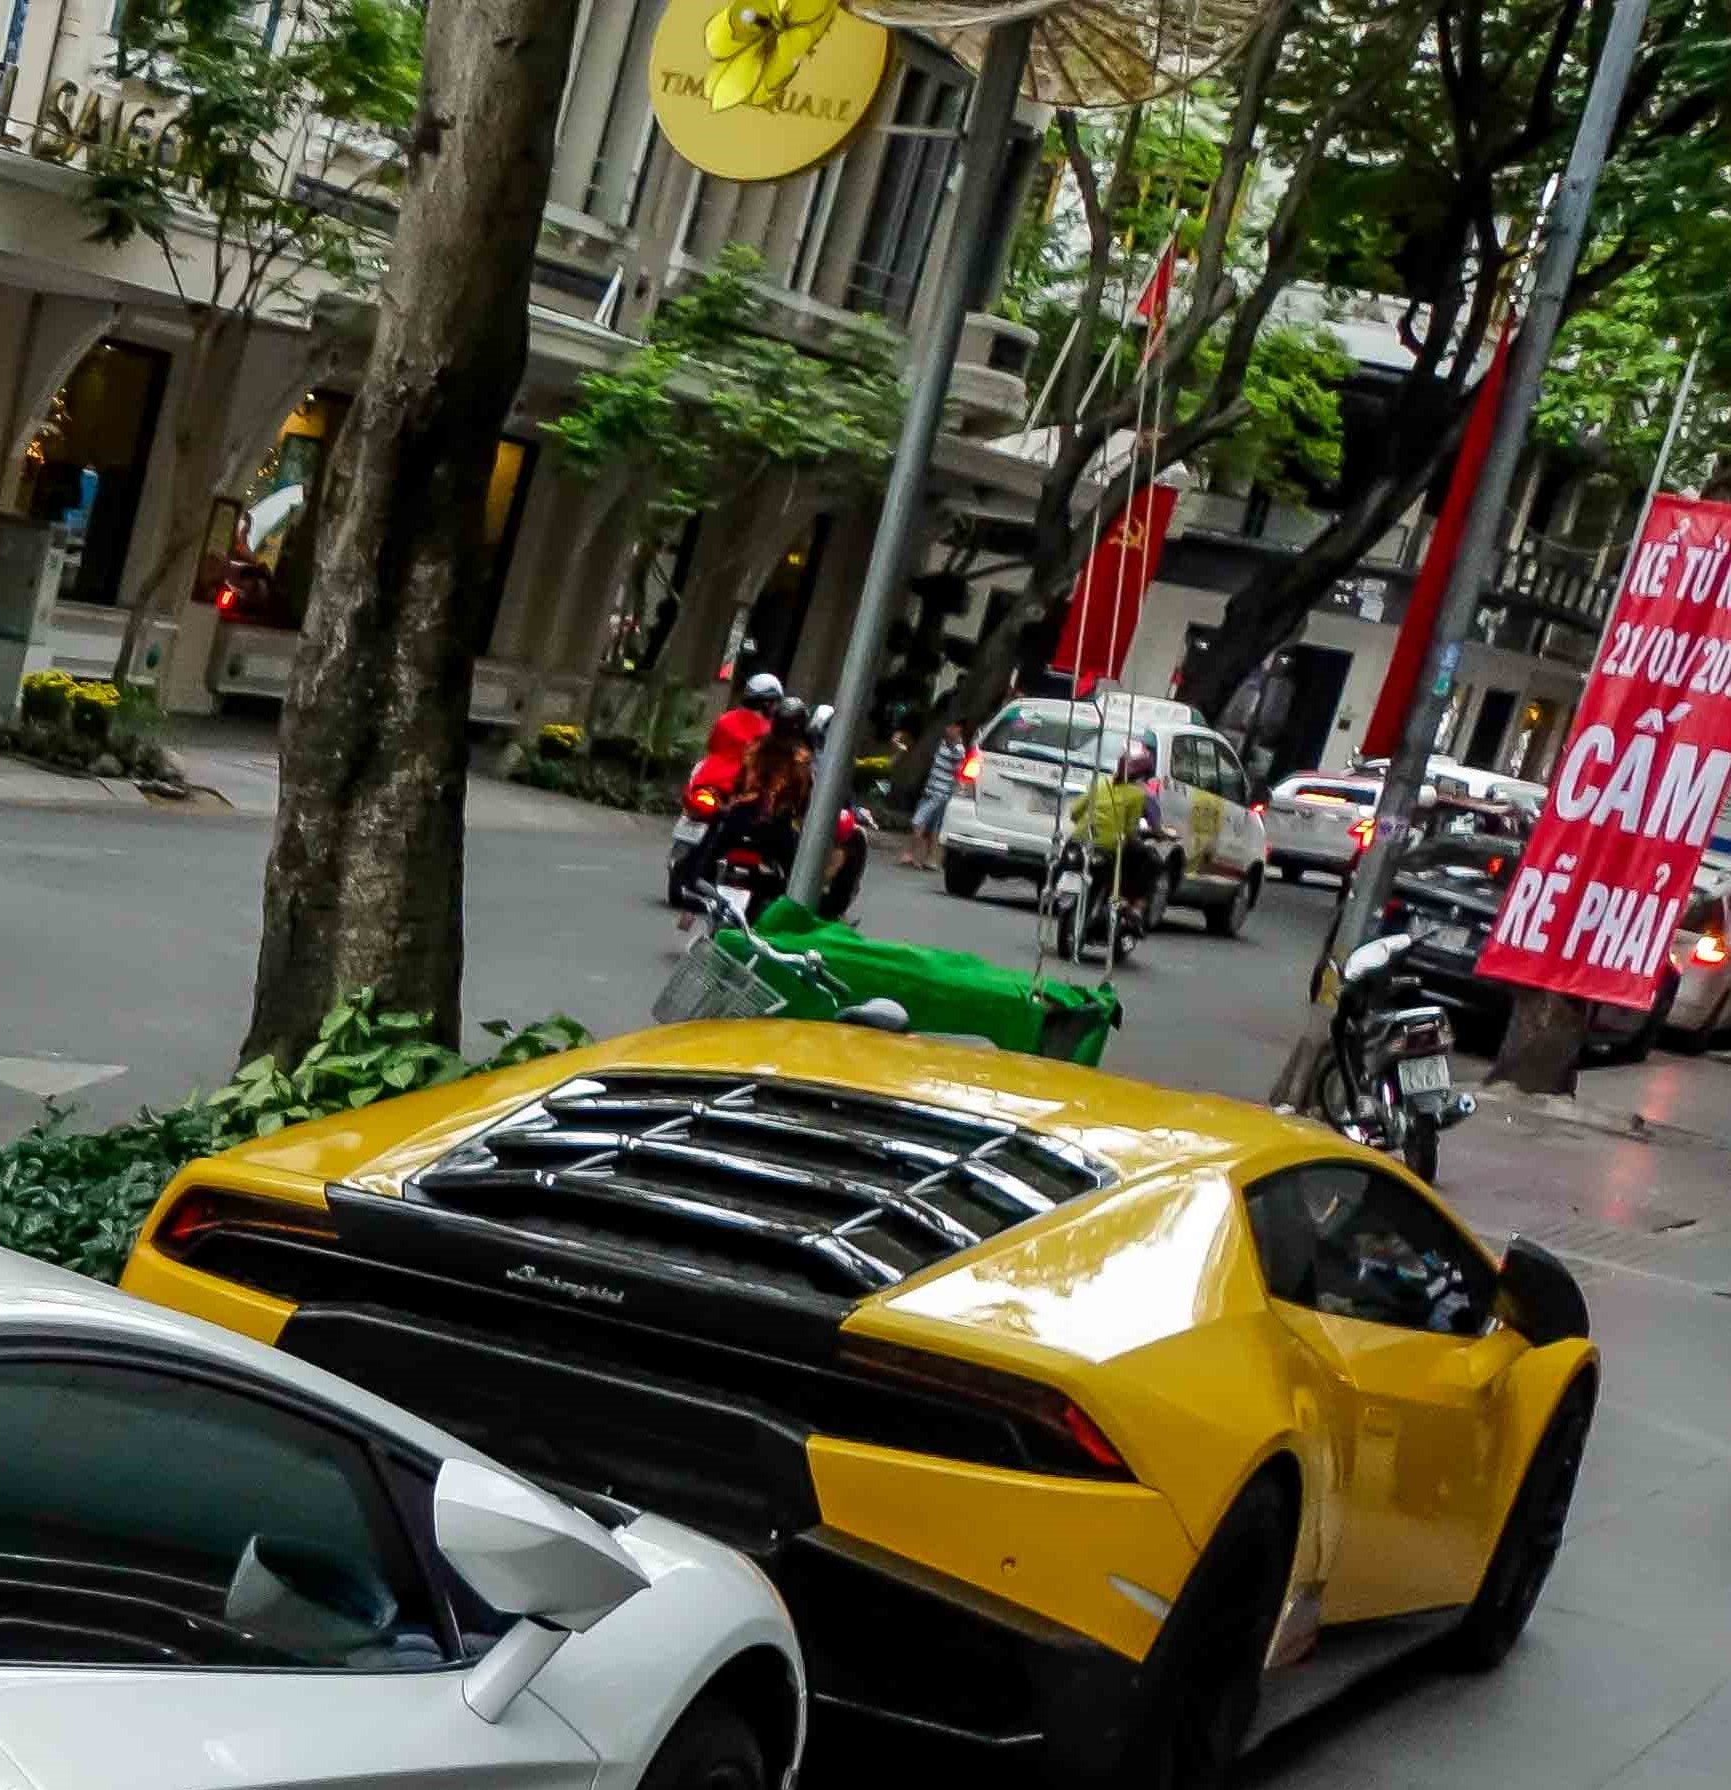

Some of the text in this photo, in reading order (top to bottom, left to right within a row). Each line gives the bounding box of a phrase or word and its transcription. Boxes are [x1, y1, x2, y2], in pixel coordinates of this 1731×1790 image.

[660, 70, 707, 99] TIM
[1601, 621, 1731, 697] 21/01/20
[1556, 701, 1731, 847] CẤM
[1496, 853, 1681, 978] RẼ PHẢI
